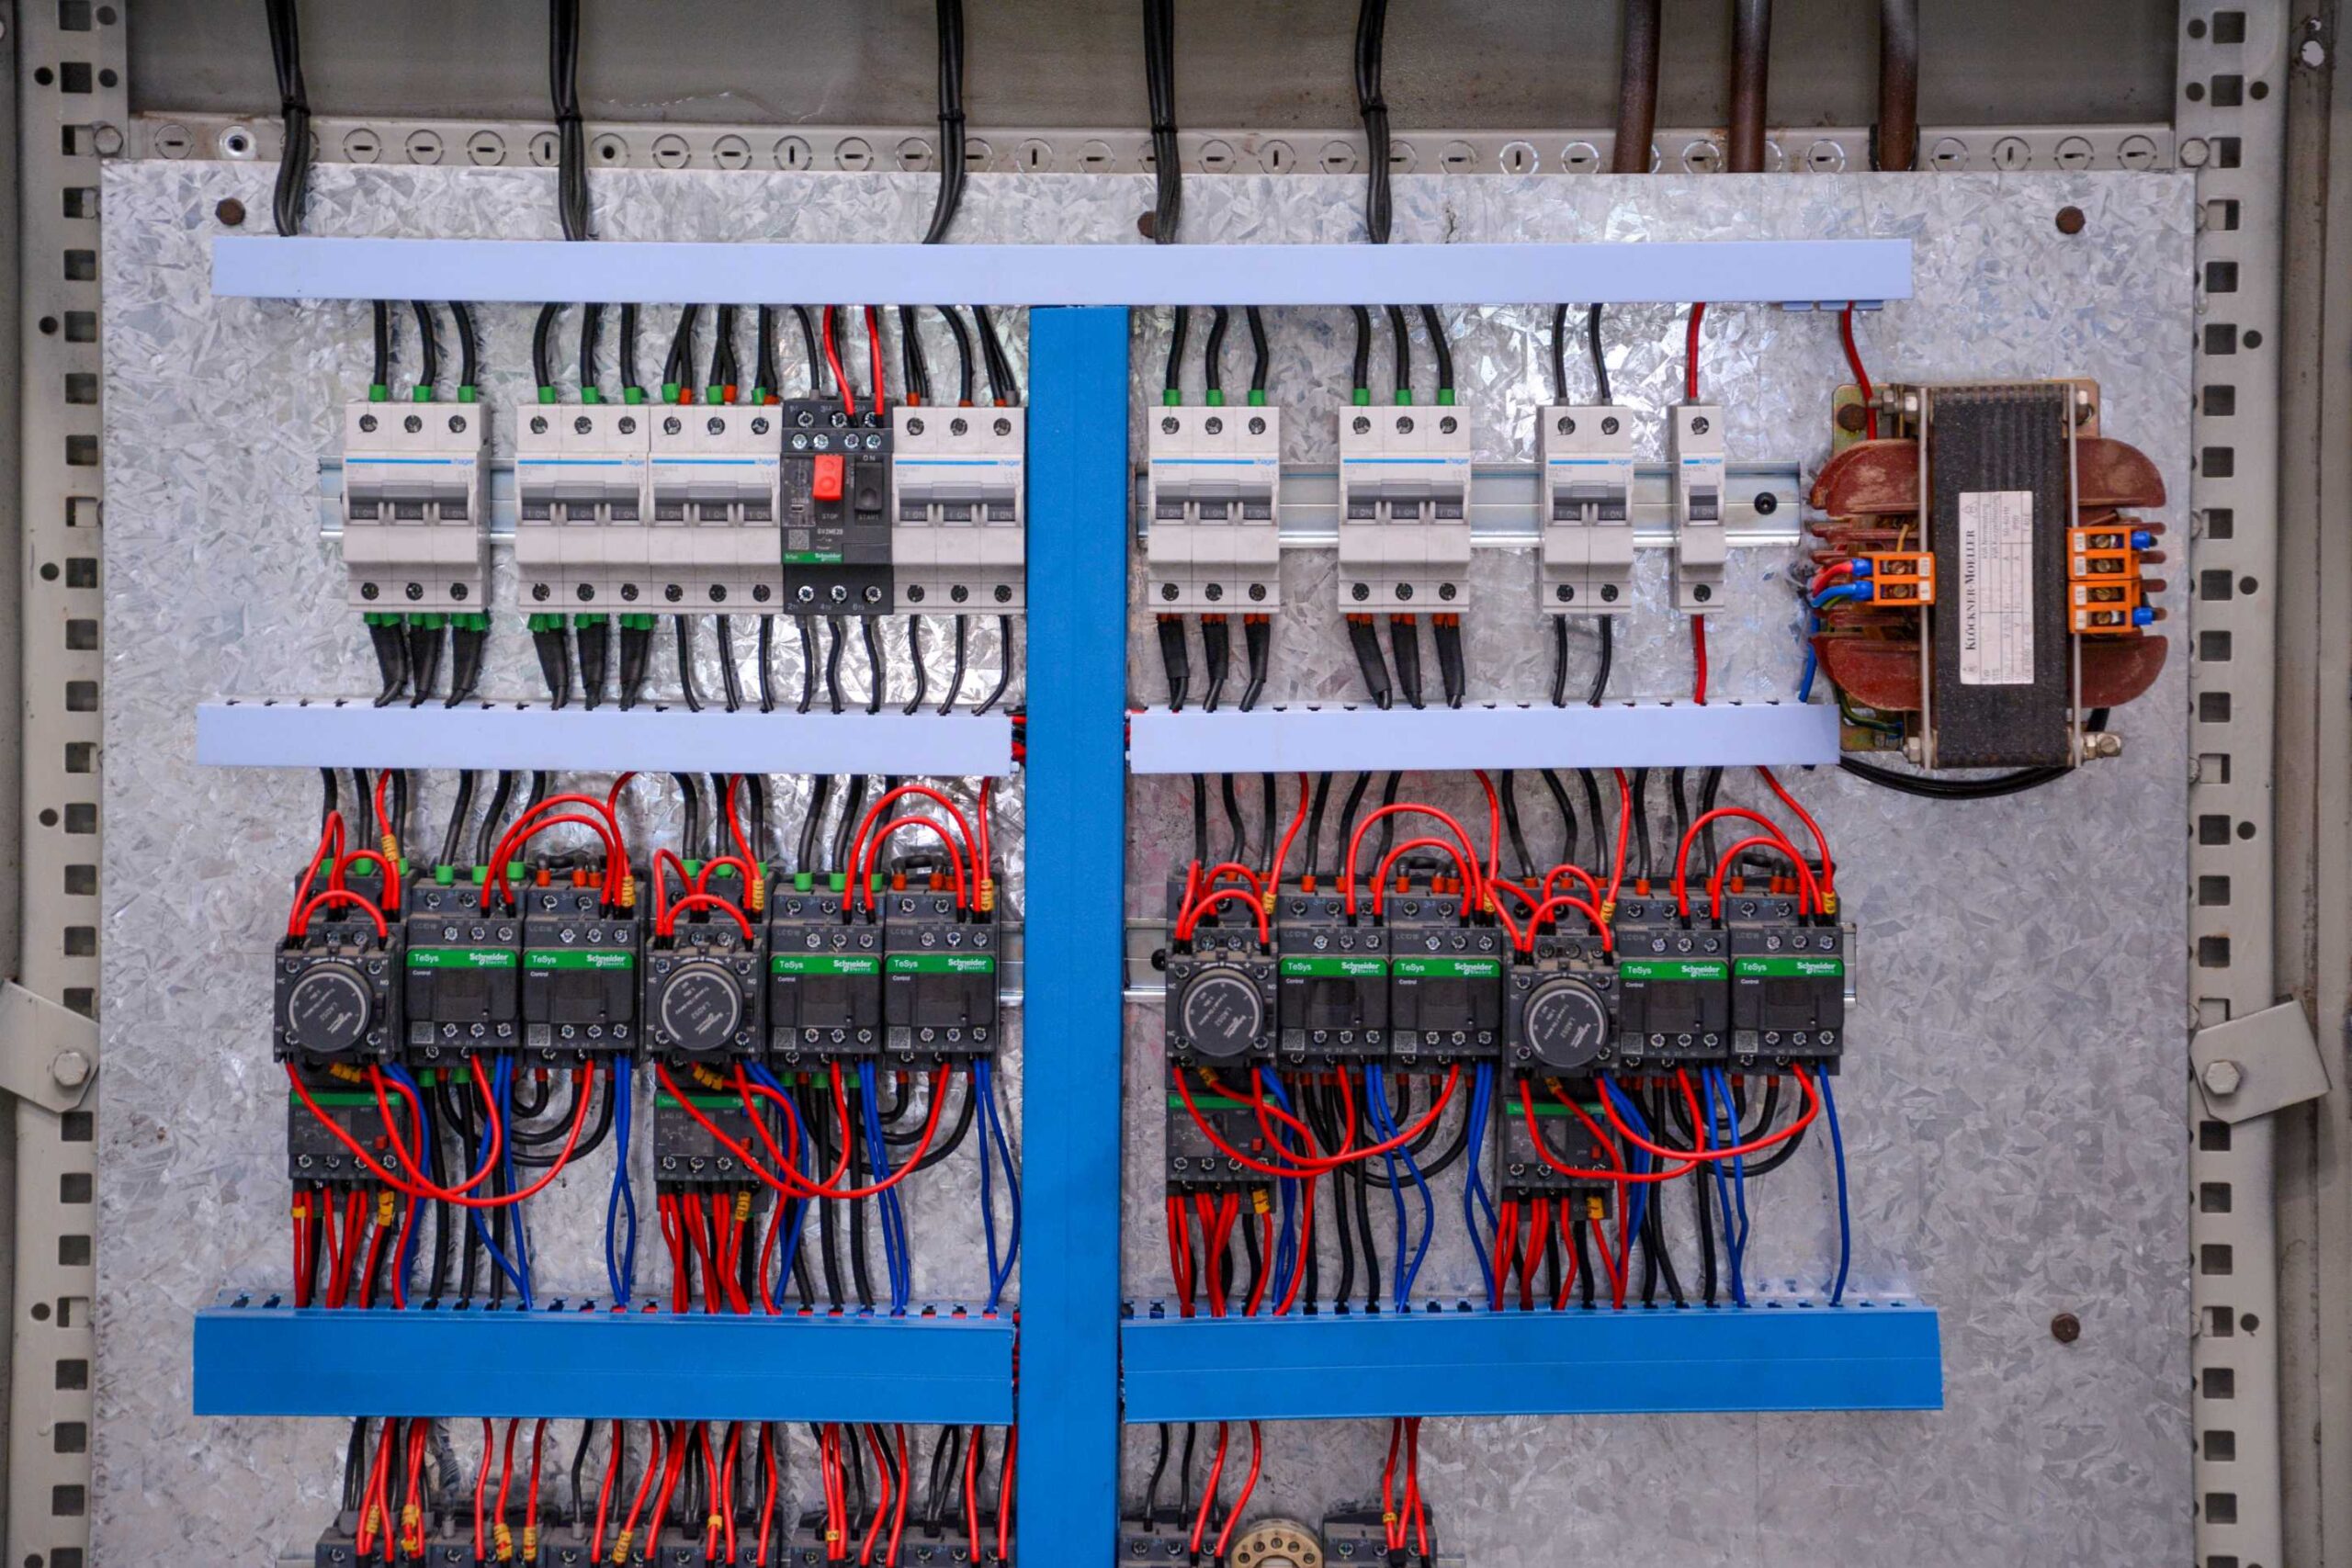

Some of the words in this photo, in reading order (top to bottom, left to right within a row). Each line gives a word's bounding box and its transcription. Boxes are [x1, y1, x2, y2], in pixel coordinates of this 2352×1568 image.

[414, 953, 439, 963] TeSys
[469, 953, 508, 965] Schneider
[532, 955, 557, 964] TeSys
[586, 954, 626, 967] Schneider
[895, 959, 918, 968] TeSys
[948, 958, 987, 971] Schneider
[780, 961, 803, 970] TeSys
[833, 960, 872, 973] Schneider
[1288, 963, 1312, 972] TeSys
[1341, 962, 1380, 975] Schneider
[1401, 964, 1425, 973] TeSys
[1454, 963, 1493, 975] Schneider
[1627, 966, 1652, 976] TeSys
[1681, 965, 1720, 977] Schneider
[1743, 963, 1767, 972] TeSys
[1797, 962, 1836, 974] Schneider
